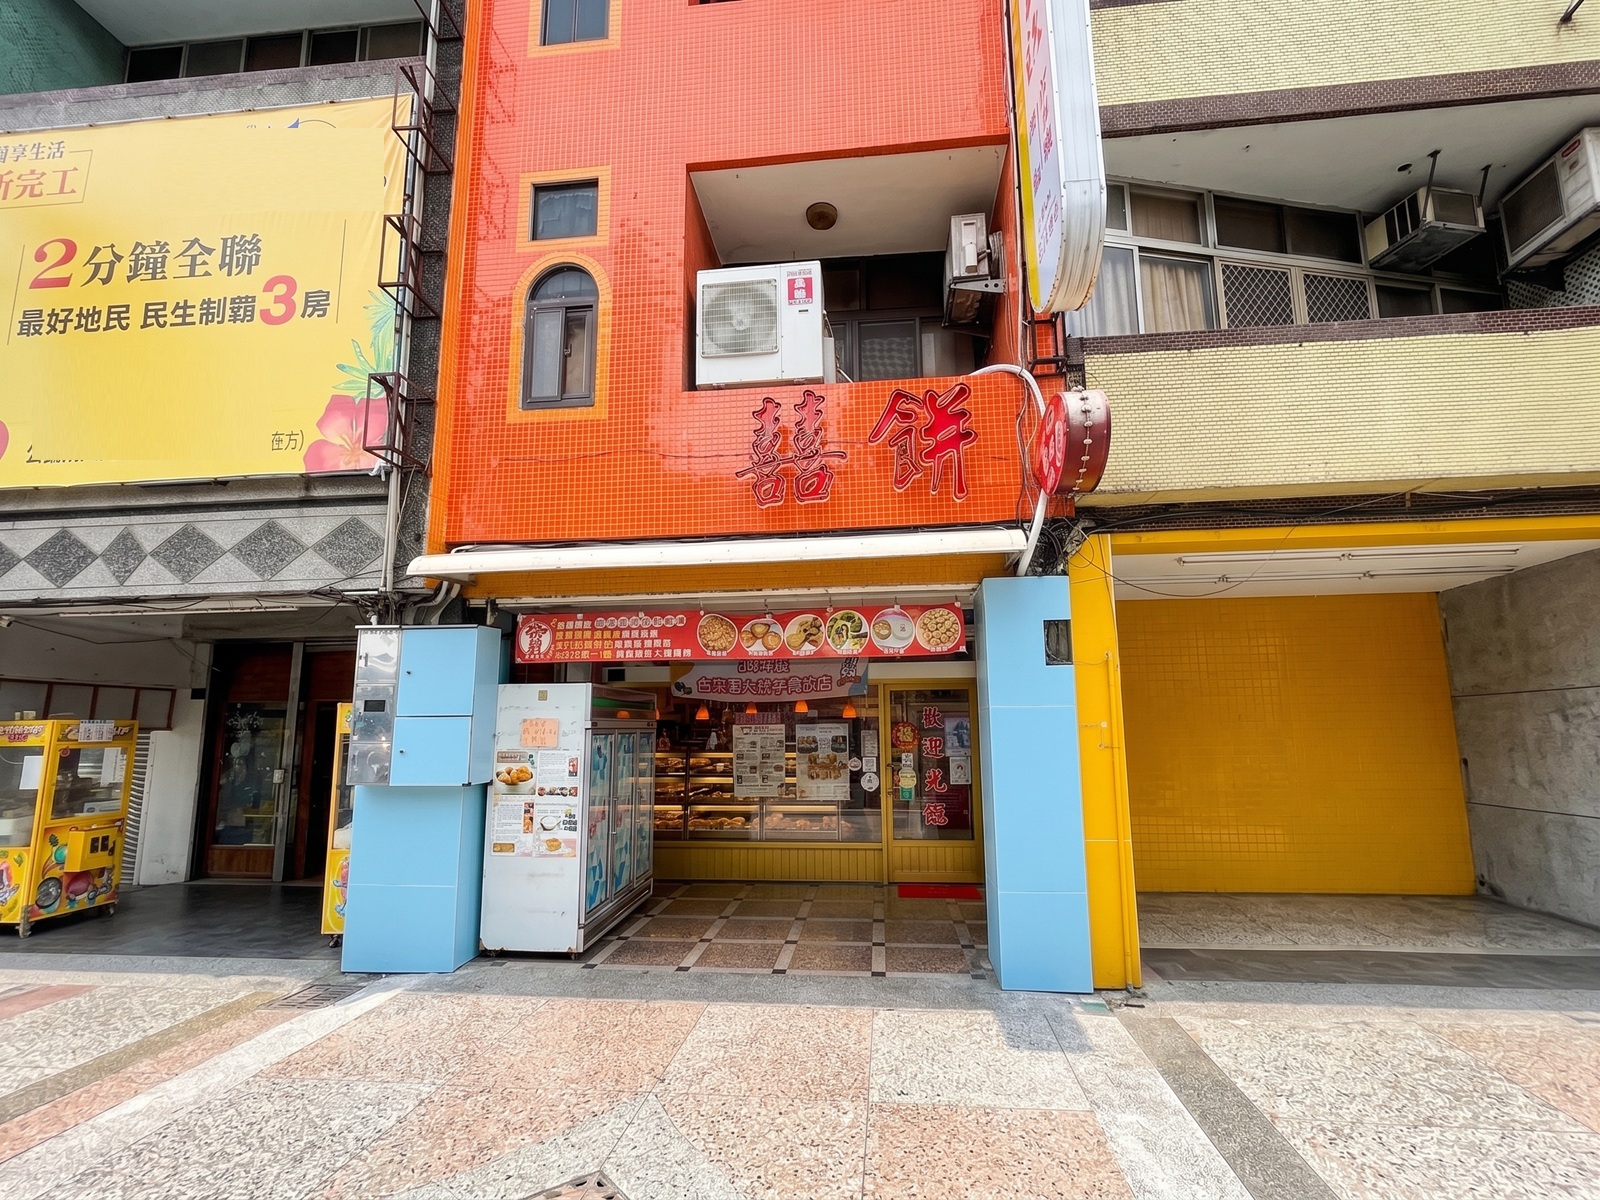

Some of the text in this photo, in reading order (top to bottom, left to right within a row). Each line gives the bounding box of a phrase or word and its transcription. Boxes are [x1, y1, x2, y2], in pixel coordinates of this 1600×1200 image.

[29, 233, 263, 290] 2分鐘全聯
[17, 304, 131, 338] 最好地民
